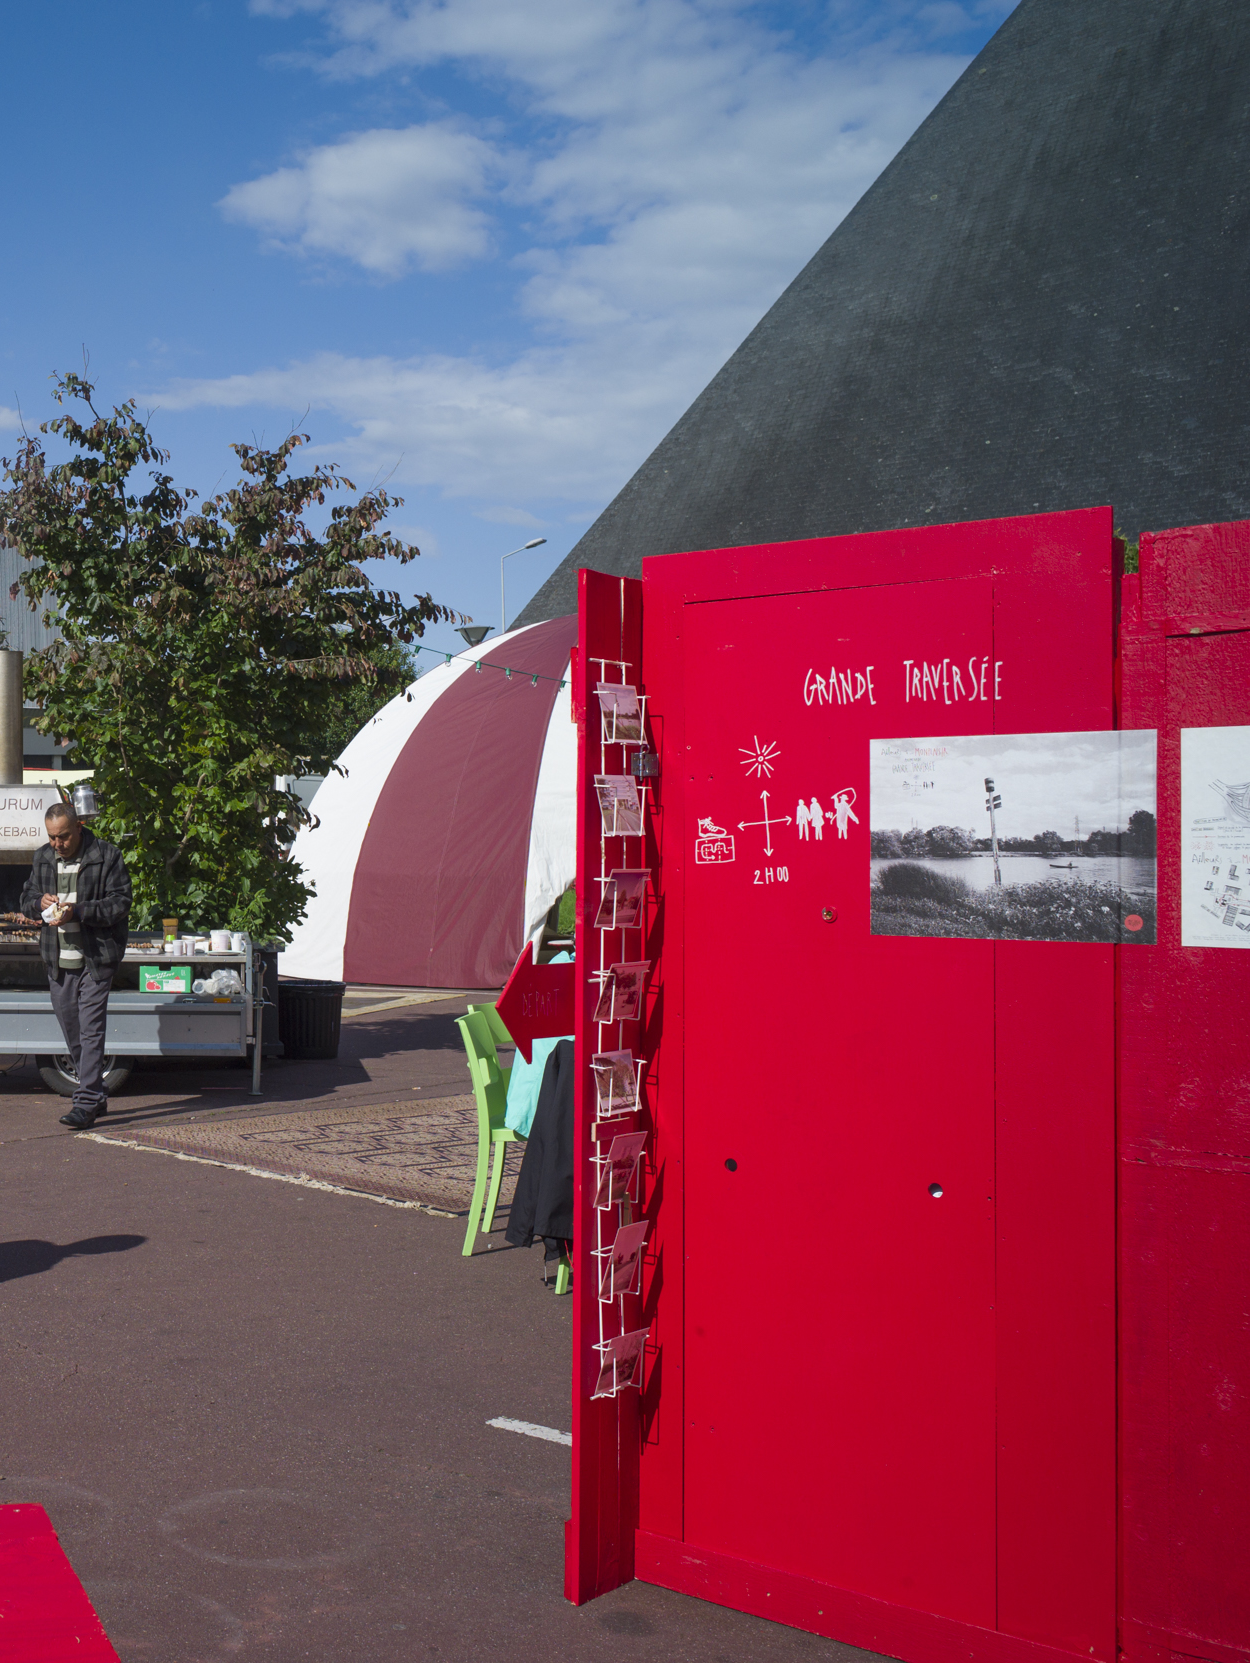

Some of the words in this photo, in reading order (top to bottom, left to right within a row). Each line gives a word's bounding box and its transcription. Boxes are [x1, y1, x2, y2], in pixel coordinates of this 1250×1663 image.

[803, 665, 877, 706] GRANDE
[903, 656, 1003, 705] TRAVERSÉE
[522, 983, 560, 1017] DÉPART
